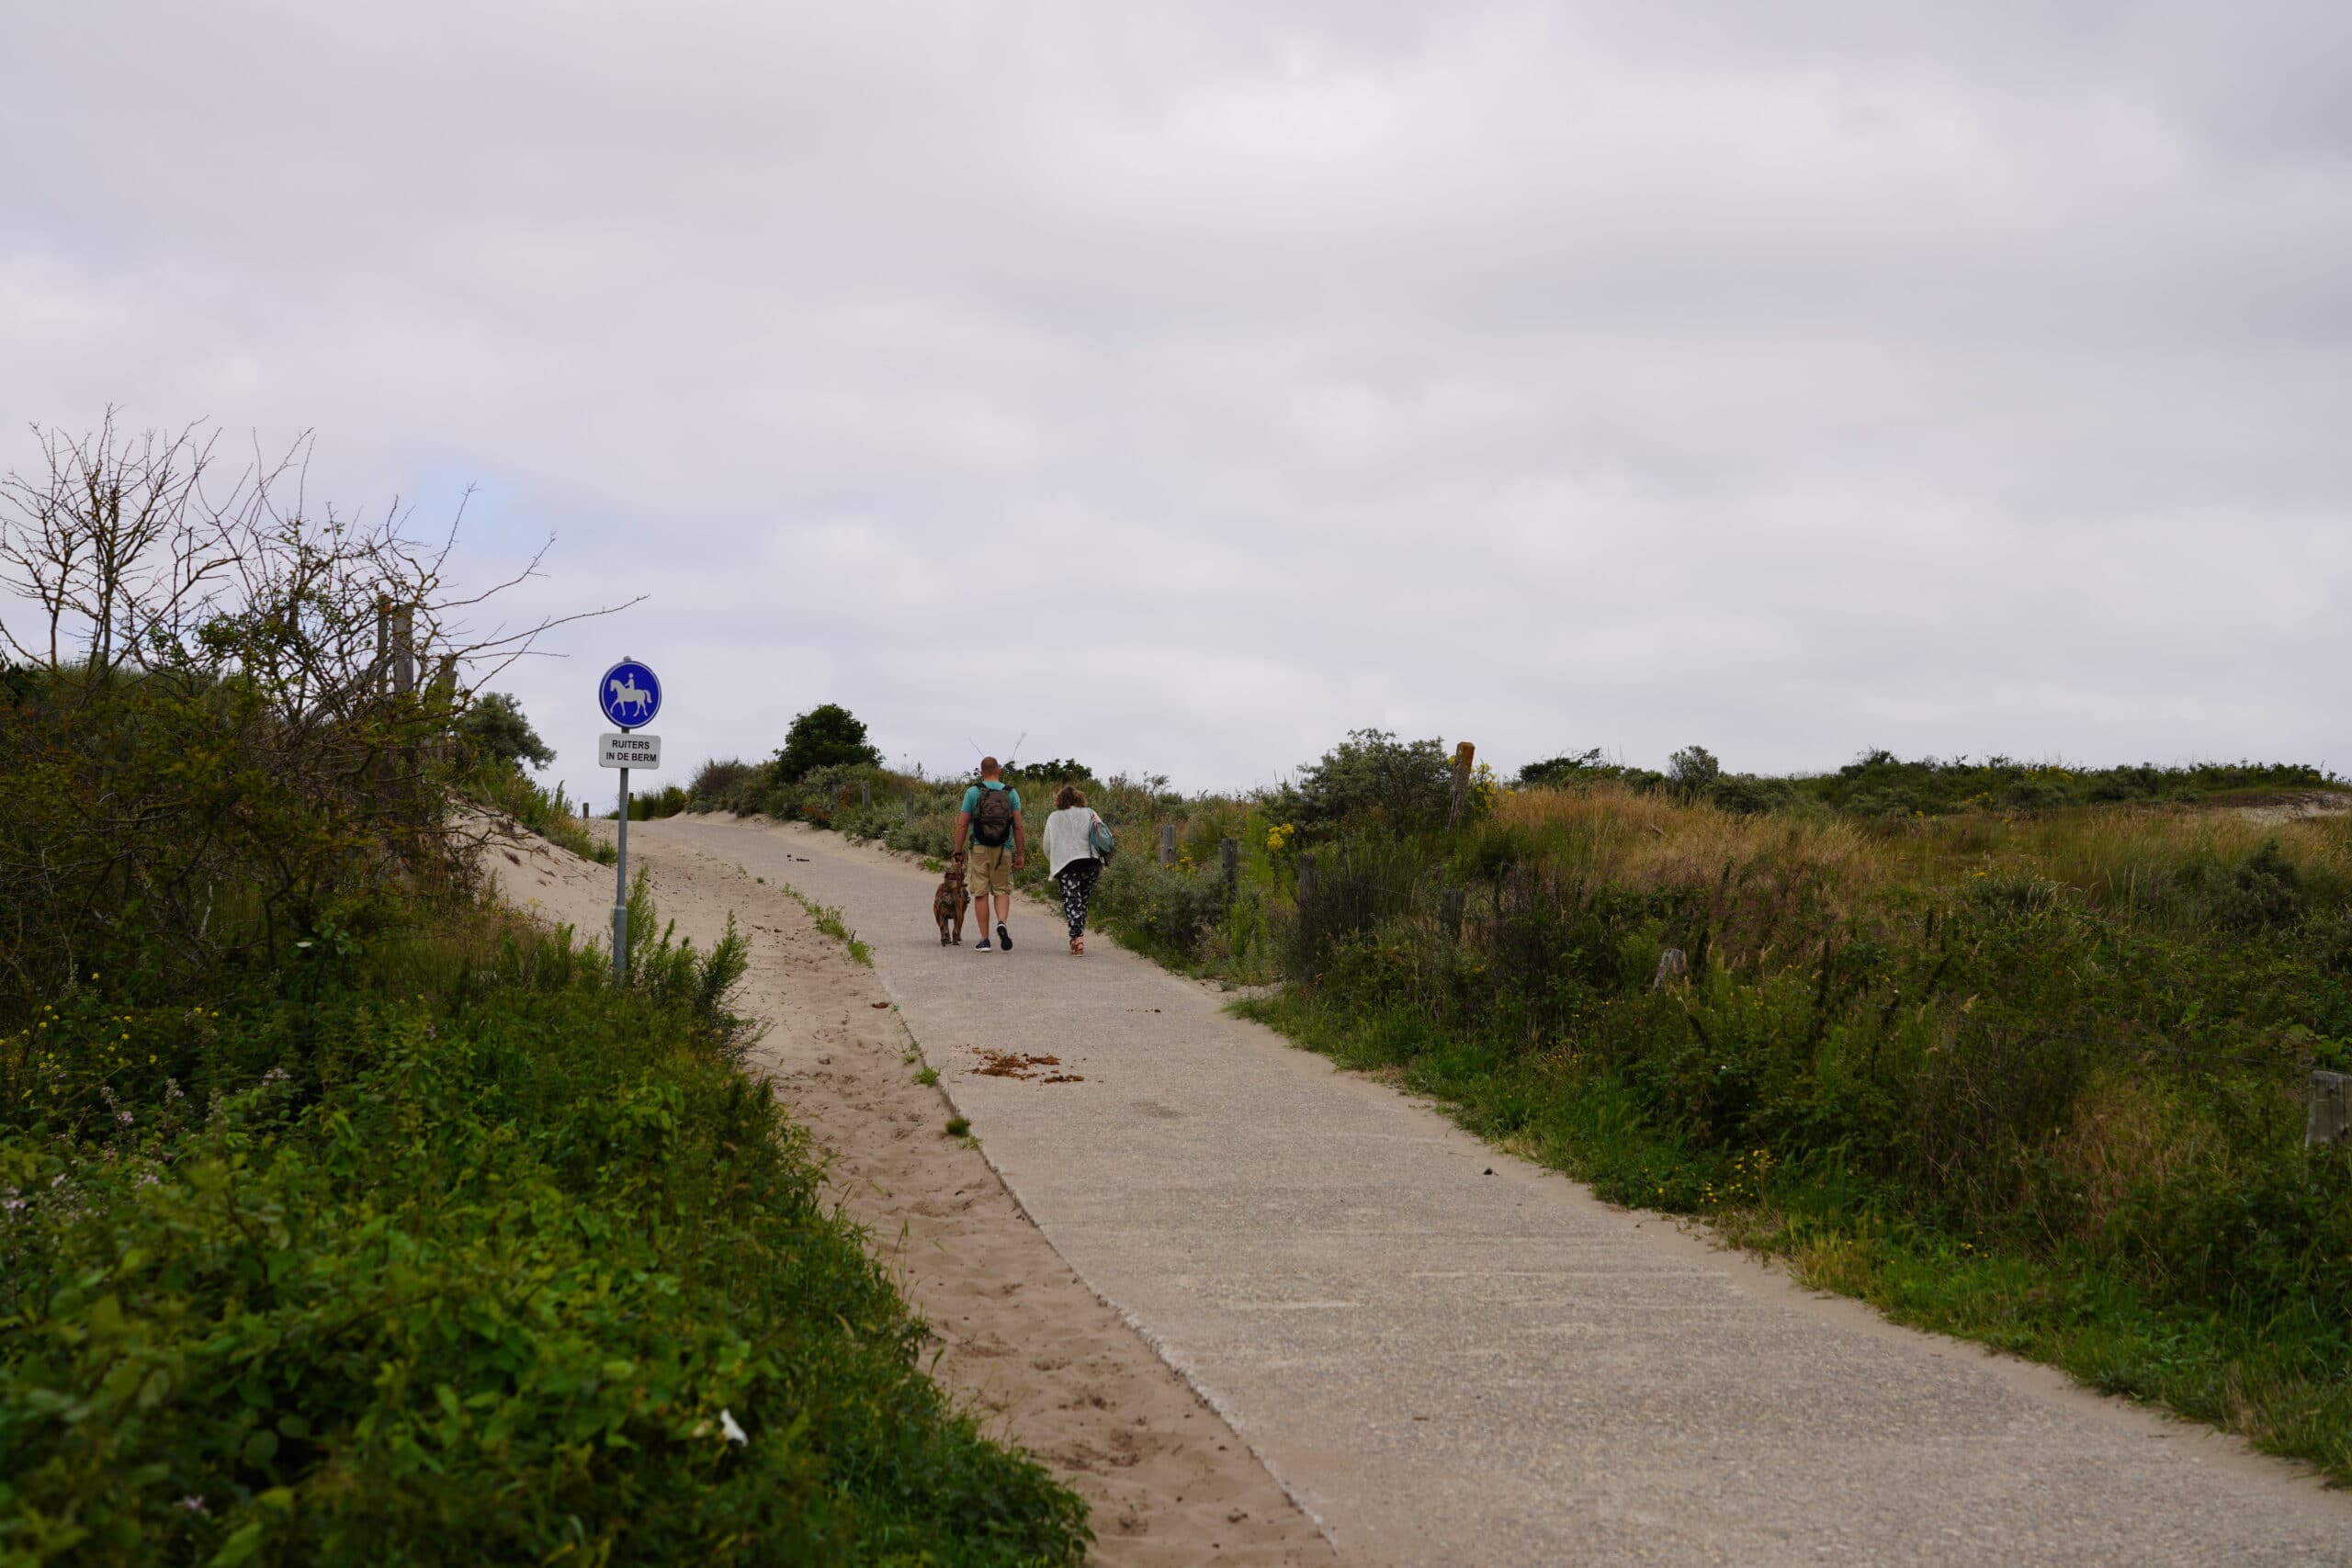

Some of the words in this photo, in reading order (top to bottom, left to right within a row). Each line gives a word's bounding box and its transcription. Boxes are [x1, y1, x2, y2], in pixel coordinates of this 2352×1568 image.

[612, 739, 650, 750] RUITERS
[606, 751, 615, 761] IN
[617, 752, 629, 761] DE
[632, 753, 657, 762] BERM
